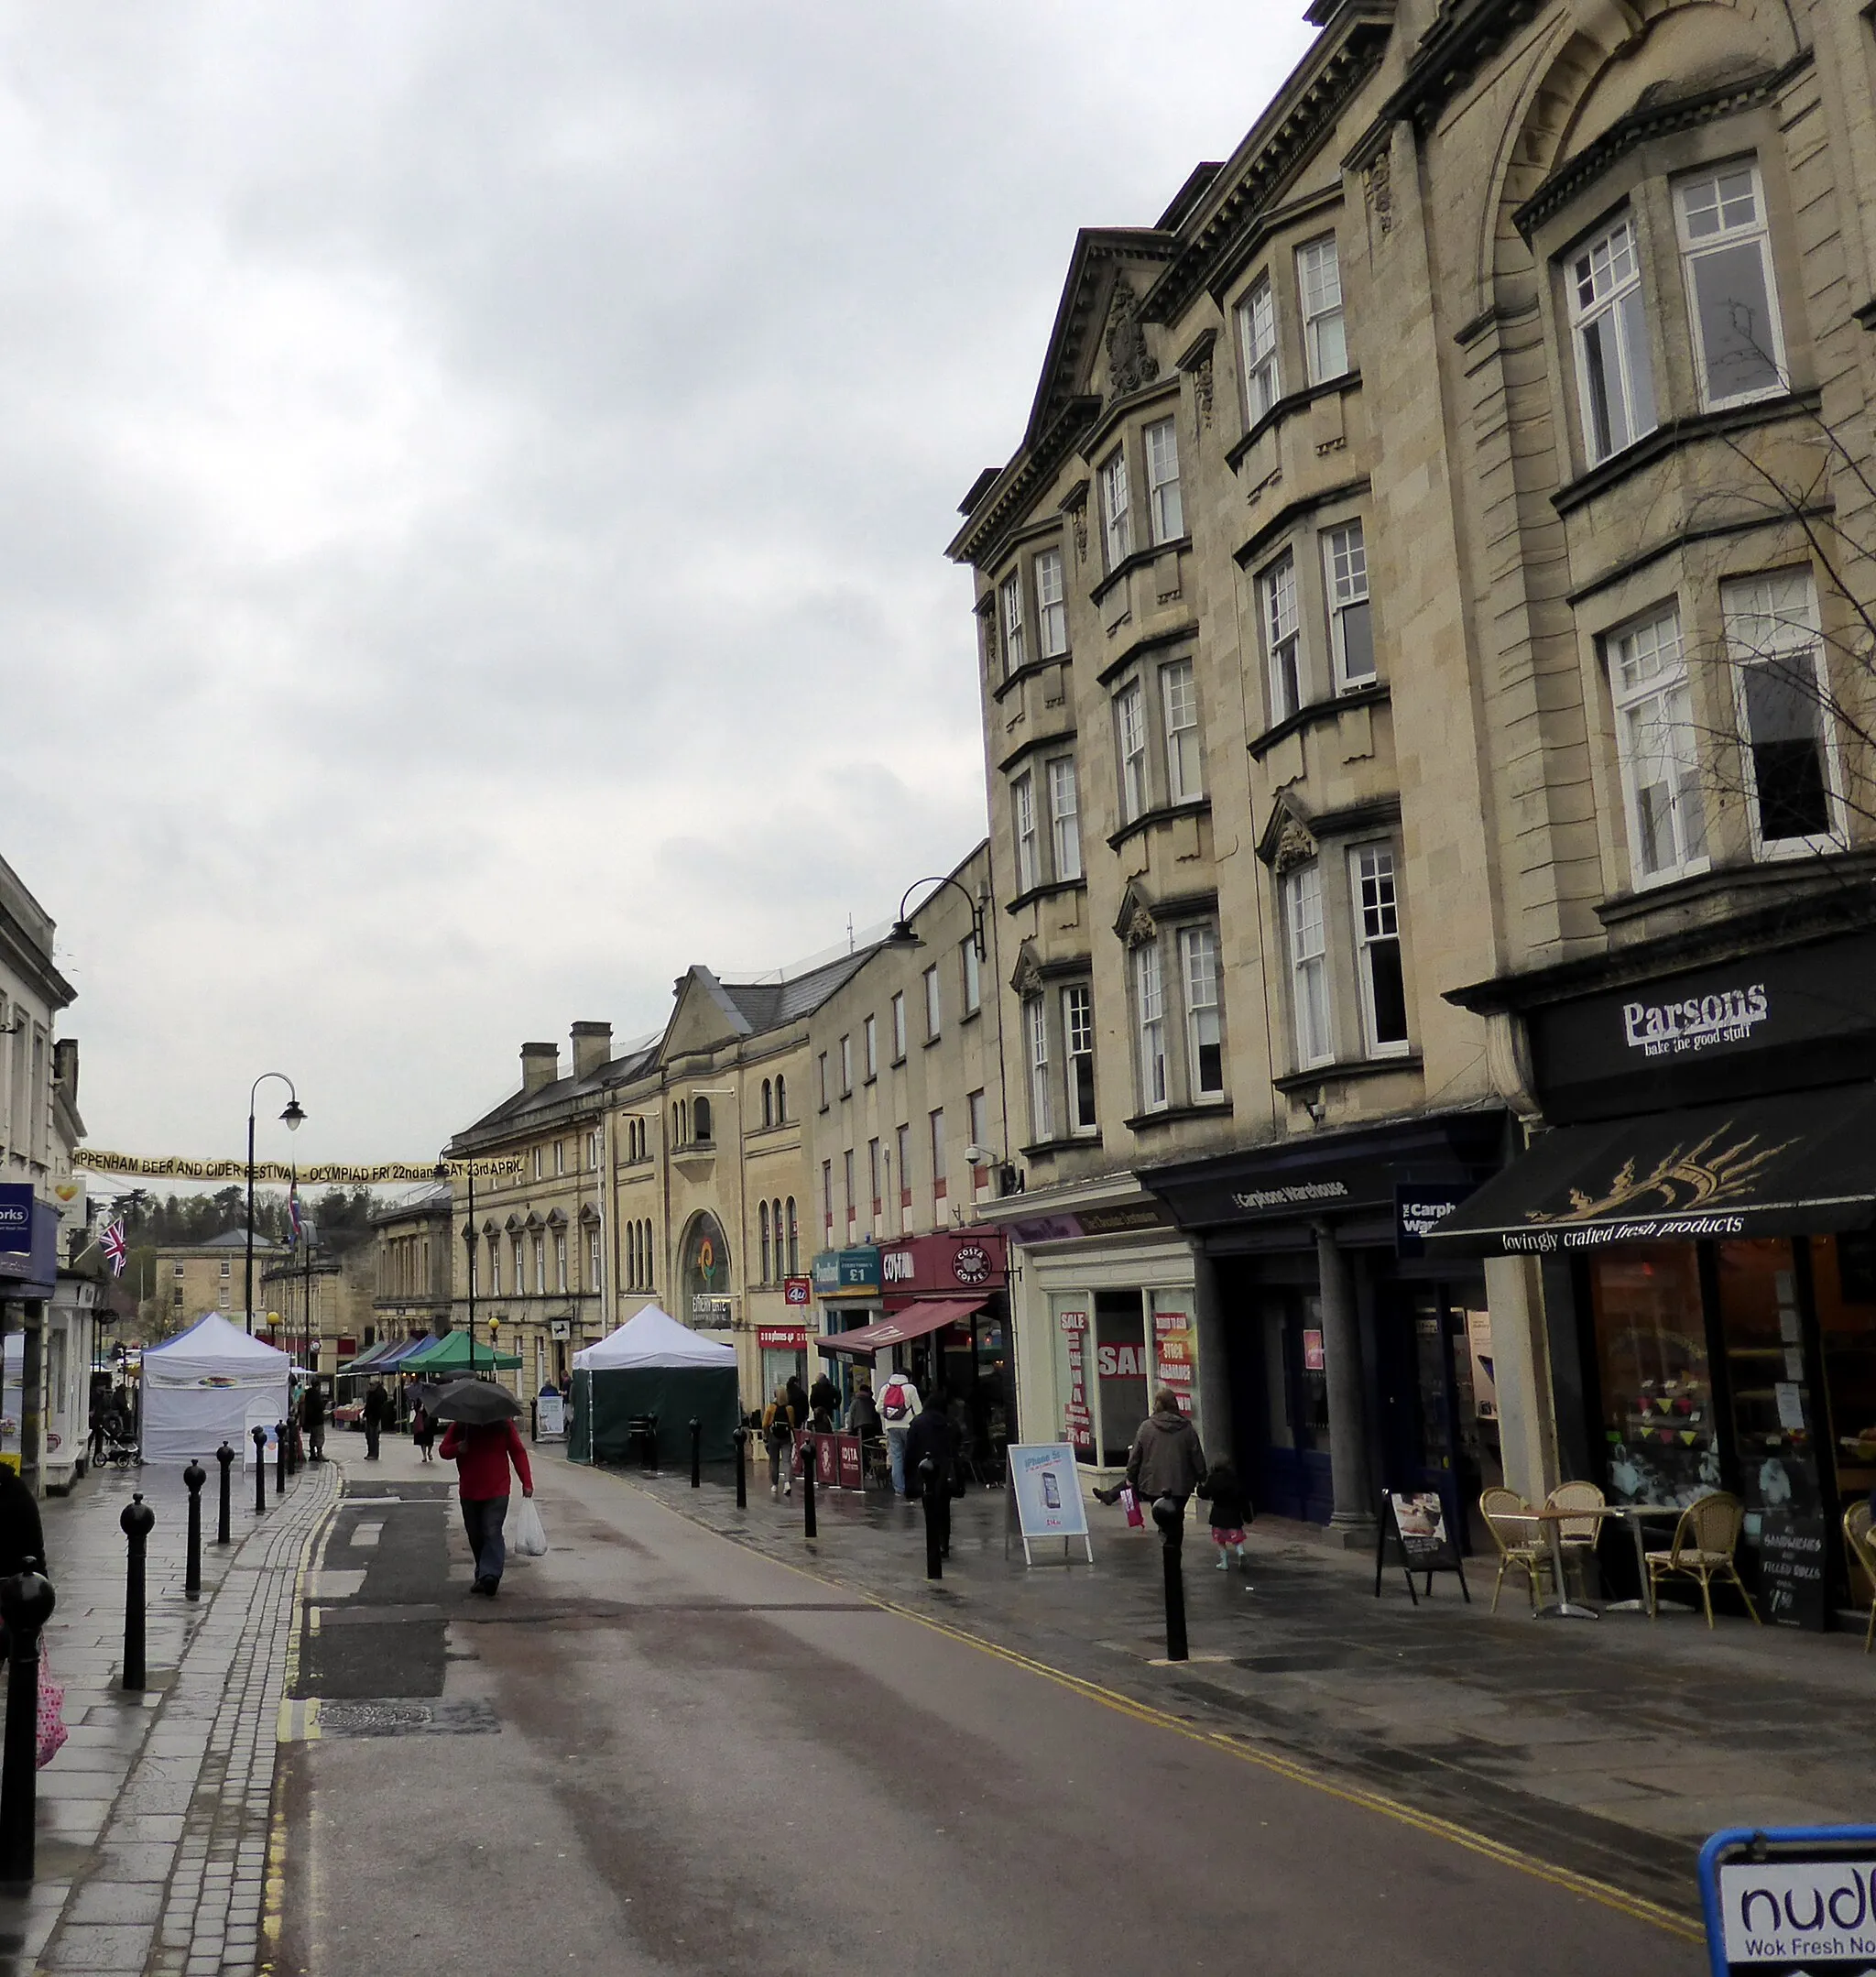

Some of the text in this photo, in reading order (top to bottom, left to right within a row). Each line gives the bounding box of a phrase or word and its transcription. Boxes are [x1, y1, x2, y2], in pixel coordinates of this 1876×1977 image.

[1623, 984, 1768, 1046] Parsons
[1644, 1040, 1671, 1057] bake
[1694, 1025, 1721, 1052] good
[142, 1159, 174, 1174] BEER
[176, 1160, 202, 1176] AND
[206, 1162, 241, 1177] CIDER
[310, 1166, 369, 1182] OLYMPIAD
[372, 1165, 391, 1180] FRI
[489, 1159, 523, 1176] APRIL
[1238, 1189, 1287, 1209] Carphone
[1282, 1181, 1348, 1202] Warehouse
[0, 1208, 23, 1220] orks
[1411, 1202, 1456, 1218] Carph
[1402, 1219, 1439, 1233] War
[1502, 1216, 1744, 1252] lovingly crafted fresh products
[957, 1246, 984, 1261] COSTA
[849, 1269, 865, 1282] £1
[790, 1288, 805, 1301] 4u
[1061, 1314, 1085, 1329] SALE
[1745, 1937, 1876, 1957] Wok Fresh No
